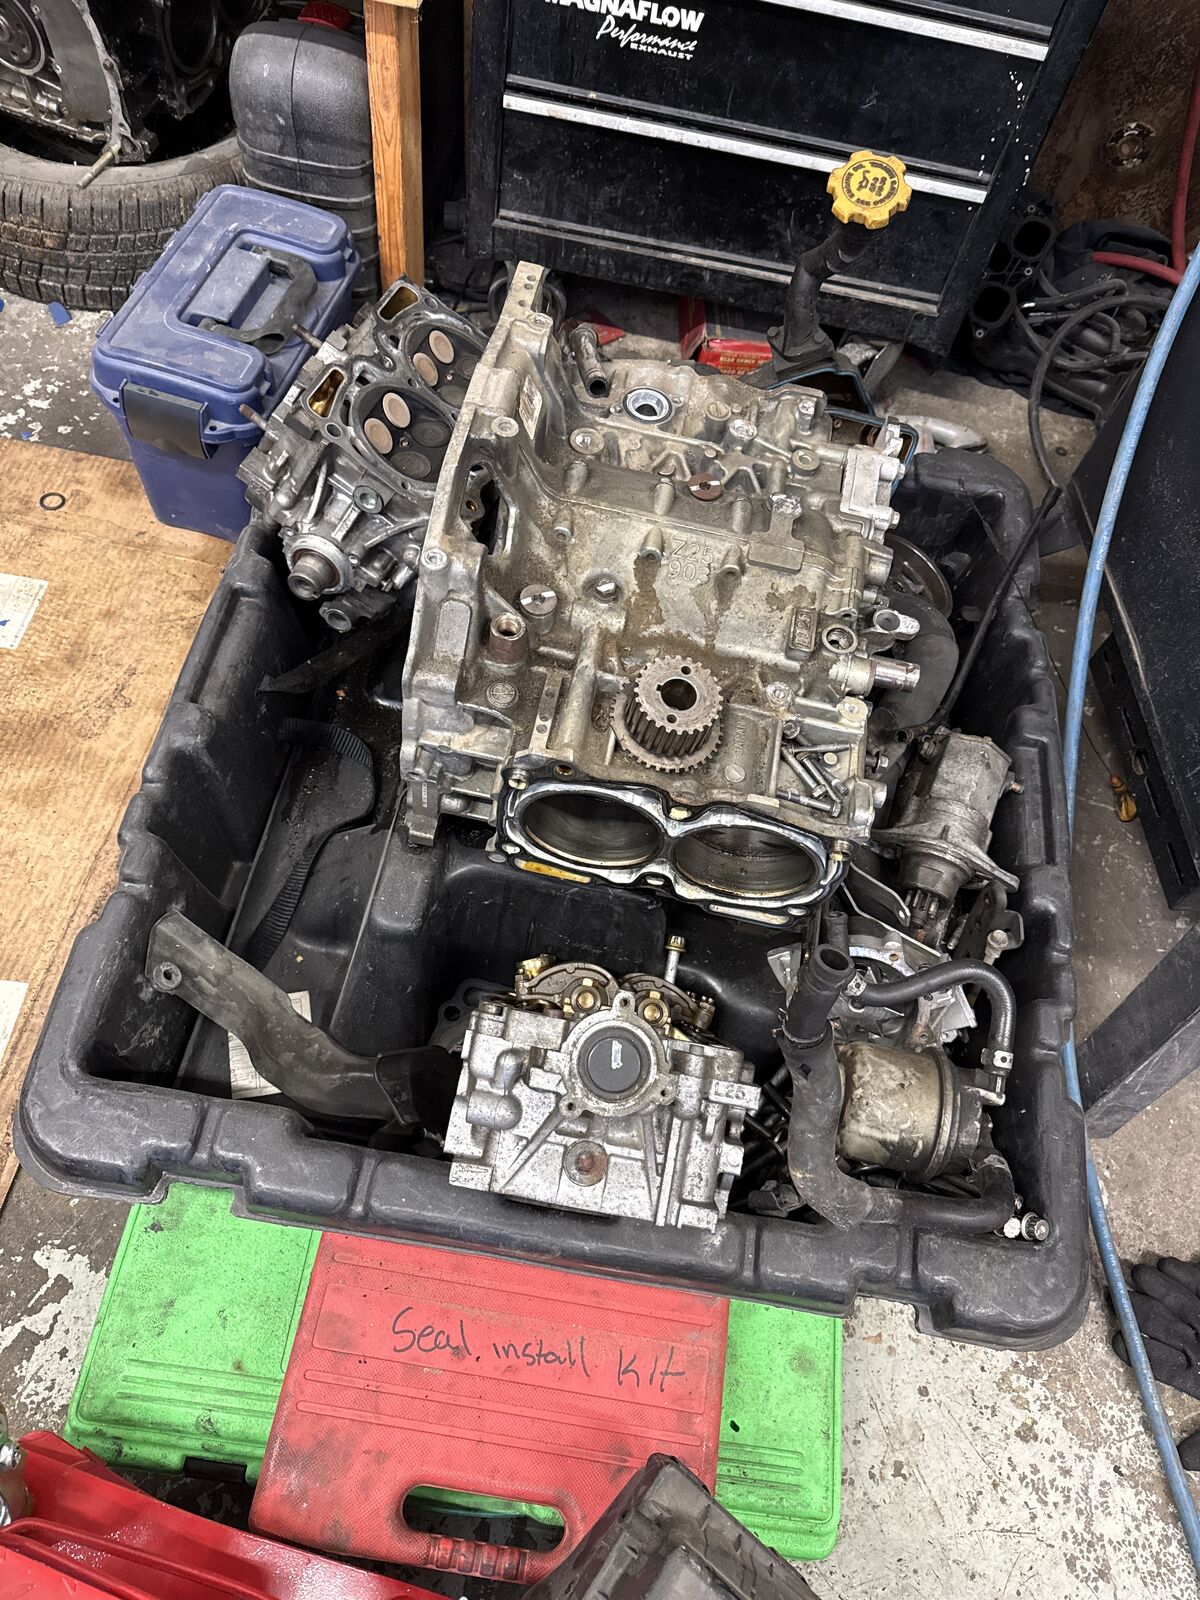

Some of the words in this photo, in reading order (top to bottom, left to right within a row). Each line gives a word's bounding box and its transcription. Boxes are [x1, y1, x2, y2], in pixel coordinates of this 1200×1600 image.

[596, 15, 697, 51] Performance
[629, 42, 694, 61] EXHAUST
[671, 539, 714, 565] Z25
[666, 560, 710, 584] 903
[391, 1306, 472, 1356] Seal
[492, 1335, 590, 1378] install
